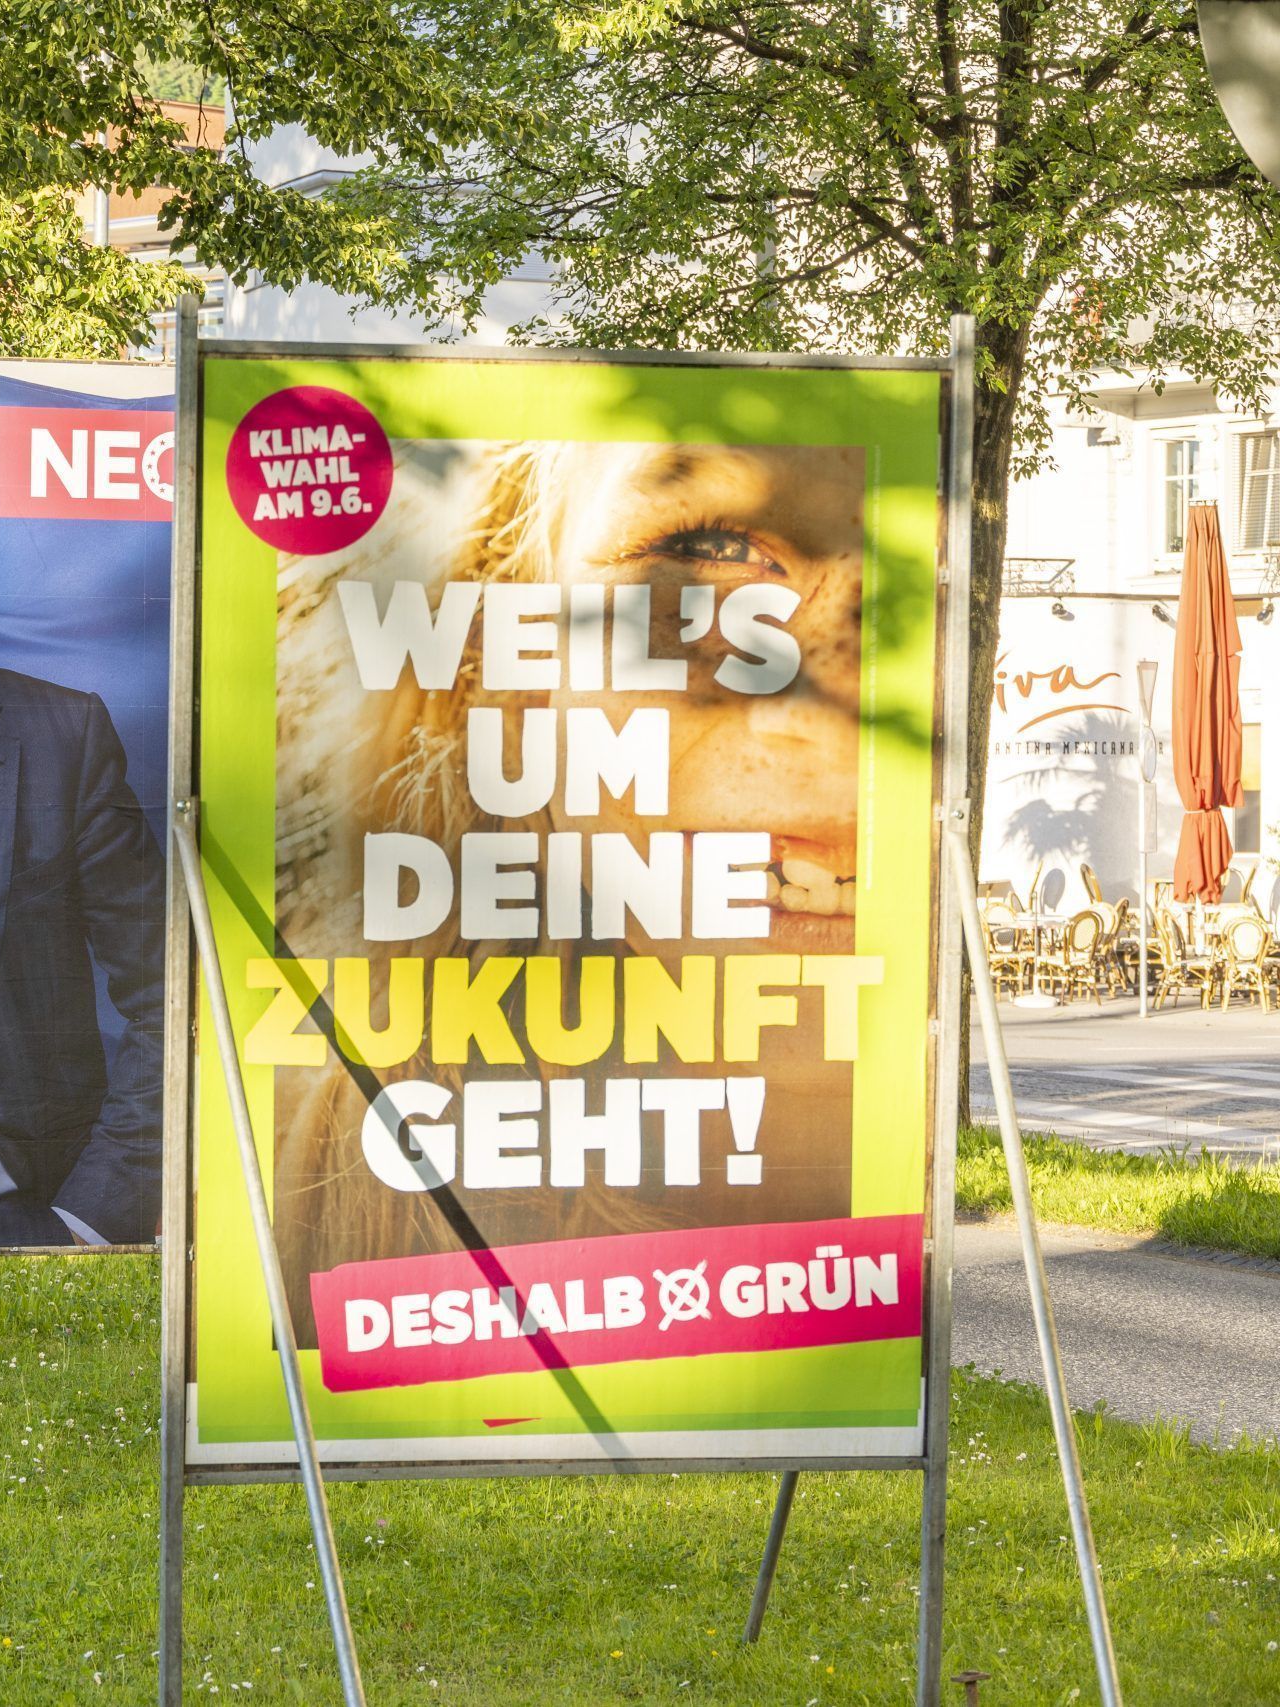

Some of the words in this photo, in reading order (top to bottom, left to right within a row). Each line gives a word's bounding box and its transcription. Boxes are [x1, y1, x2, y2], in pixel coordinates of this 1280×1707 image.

[249, 424, 366, 457] KLIMA-
[260, 456, 360, 488] WAHL
[253, 491, 304, 521] AM
[310, 486, 373, 517] 9.6.
[337, 581, 802, 695] WEIL'S
[994, 650, 1122, 714] iva
[467, 707, 671, 818] UM
[995, 741, 1051, 755] ANTINA
[1063, 741, 1134, 755] MEXICANA
[363, 831, 771, 941] DEINE
[243, 954, 885, 1068] ZUKUNFT
[360, 1075, 766, 1192] GEHT!
[345, 1275, 646, 1353] DESHALB
[720, 1244, 899, 1319] GRÜN
